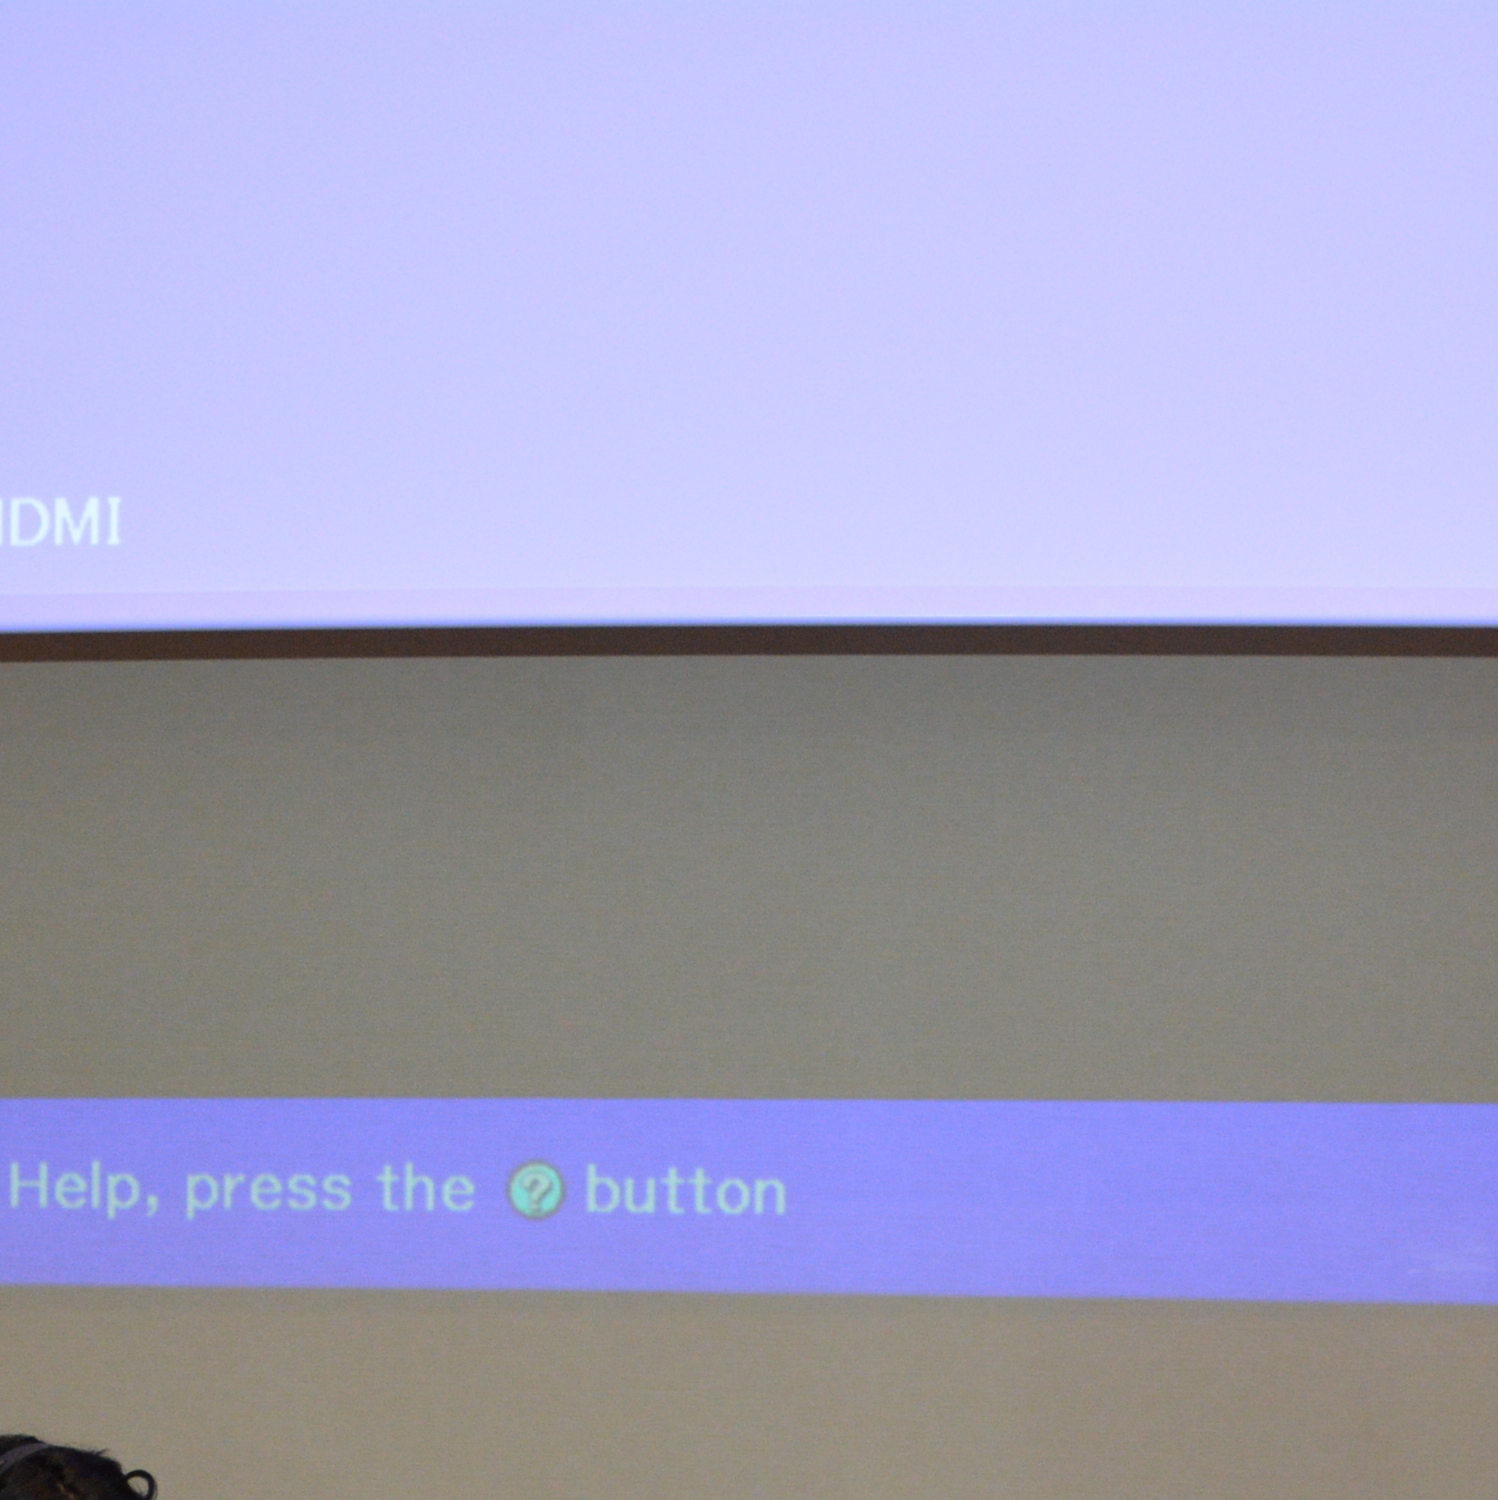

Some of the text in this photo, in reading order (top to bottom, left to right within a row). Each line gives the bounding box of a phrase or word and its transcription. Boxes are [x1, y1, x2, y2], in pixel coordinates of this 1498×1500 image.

[10, 1159, 160, 1221] Help,
[186, 1170, 352, 1221] press
[376, 1162, 476, 1212] the
[586, 1163, 787, 1215] button
